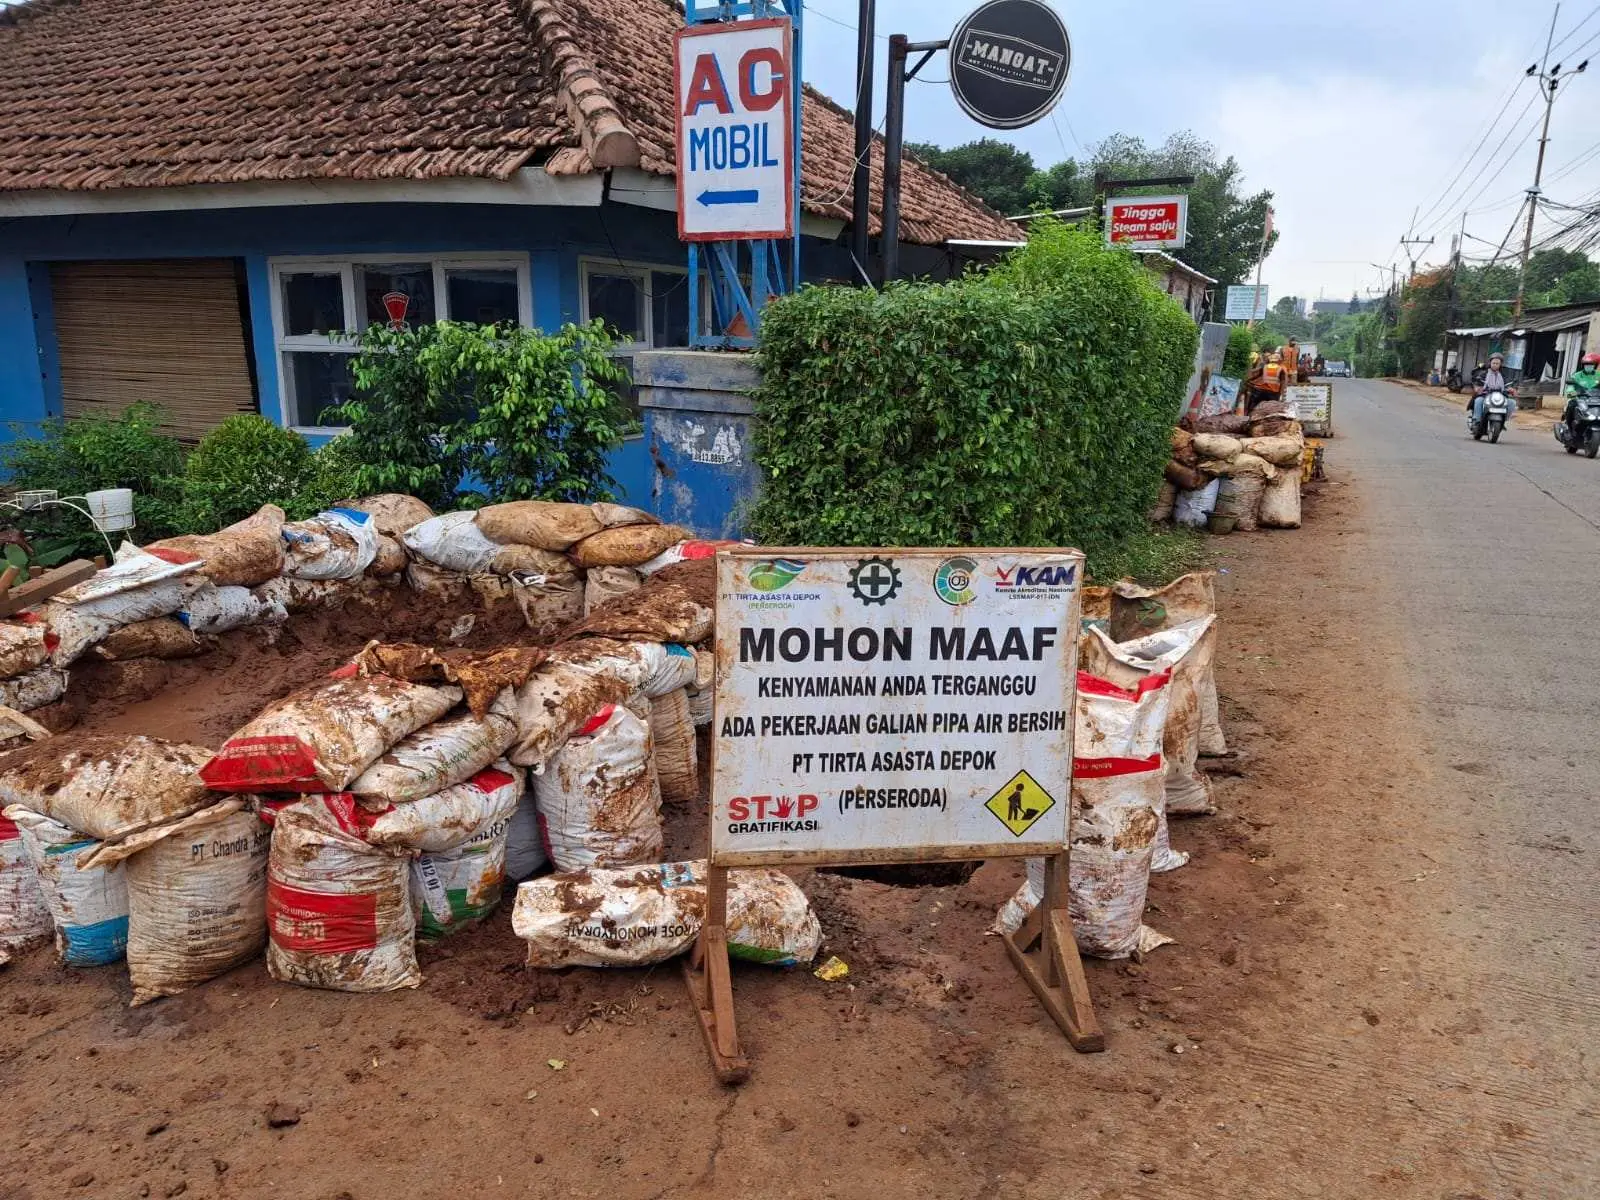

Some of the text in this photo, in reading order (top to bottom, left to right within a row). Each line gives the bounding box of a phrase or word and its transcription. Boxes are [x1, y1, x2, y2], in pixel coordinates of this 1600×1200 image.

[683, 47, 785, 117] AC
[689, 122, 778, 172] MOBIL
[1120, 207, 1166, 220] Jingga
[1113, 219, 1176, 233] Steam salju
[1016, 565, 1076, 586] KAN
[735, 593, 758, 601] TIRTA
[759, 593, 792, 602] ASASTA
[793, 593, 821, 601] DEPOK
[739, 626, 1058, 663] MOHON MAAF
[758, 674, 1037, 698] KENYAMANAN ANDA TERGANGGU
[721, 710, 1067, 738] ADA PEKERJAAN GALIAN PIPA AIR BERSIH
[792, 749, 997, 774] PT TIRTA ASASTA DEPOK
[838, 788, 948, 815] (PERSERODA)
[728, 820, 818, 834] GRATIFIKASI
[192, 843, 205, 861] PT
[212, 836, 248, 858] Chandra
[565, 924, 657, 942] MONOHYDRATE
